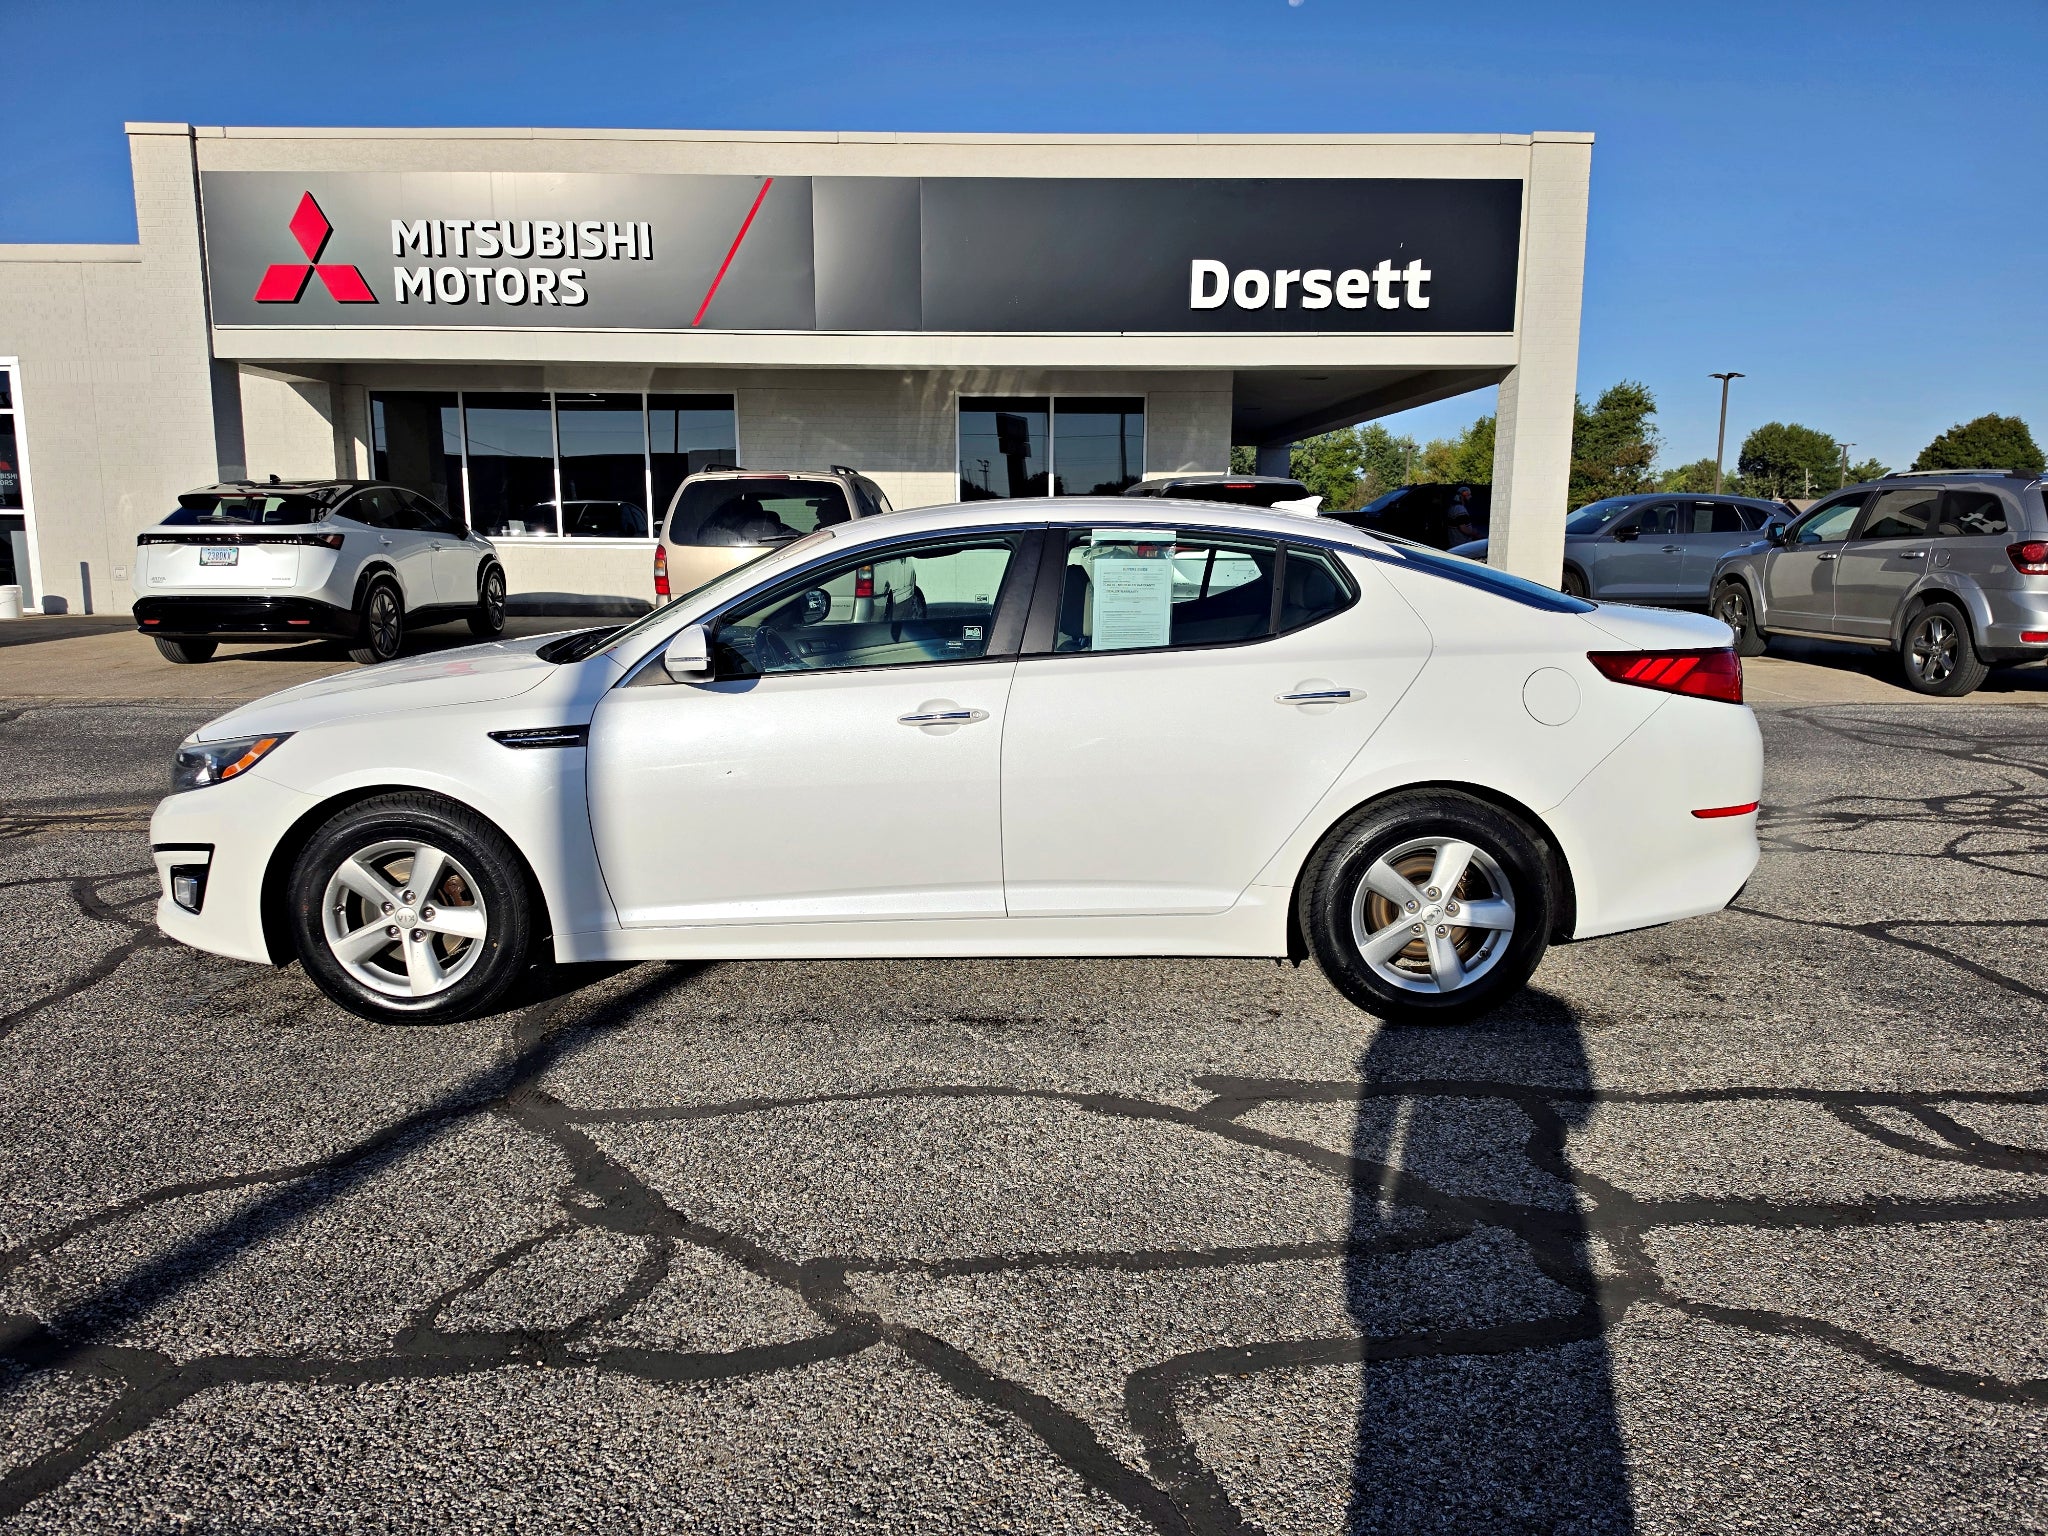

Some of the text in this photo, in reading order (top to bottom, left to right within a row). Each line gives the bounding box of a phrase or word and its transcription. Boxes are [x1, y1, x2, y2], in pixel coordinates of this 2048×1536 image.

[391, 219, 652, 259] MITSUBISHI
[394, 266, 587, 305] MOTORS
[1190, 258, 1432, 309] Dorsett
